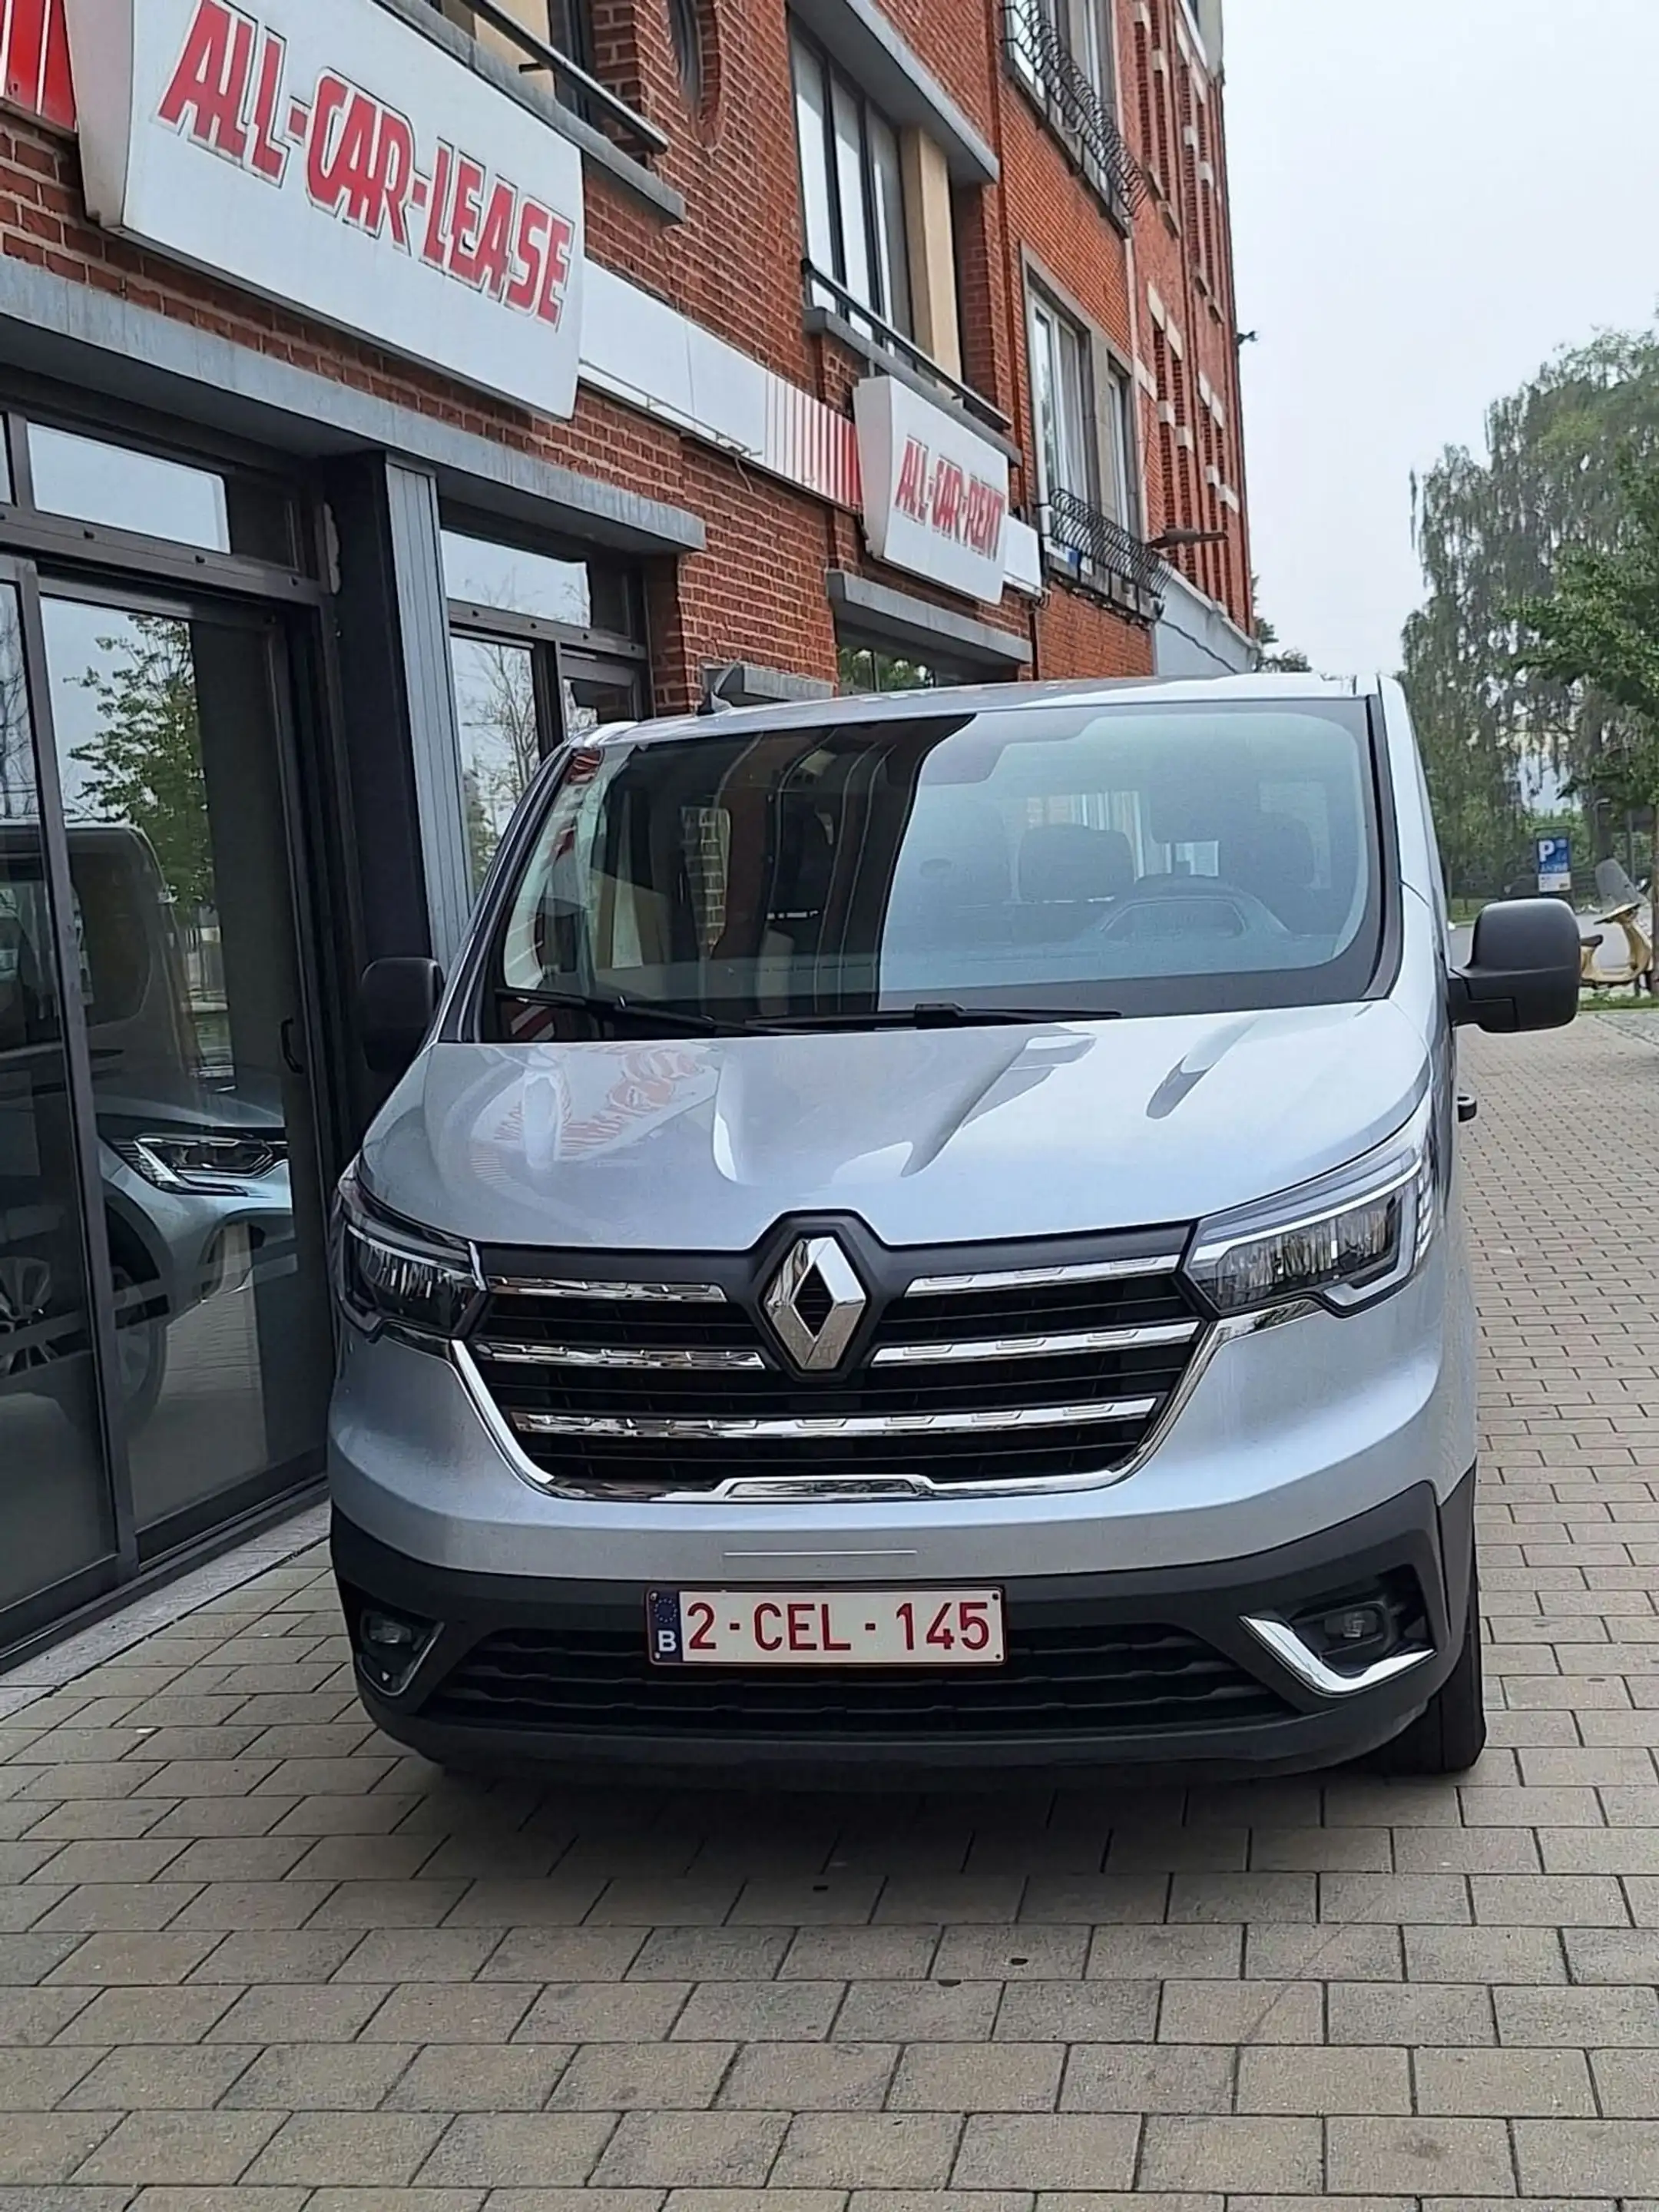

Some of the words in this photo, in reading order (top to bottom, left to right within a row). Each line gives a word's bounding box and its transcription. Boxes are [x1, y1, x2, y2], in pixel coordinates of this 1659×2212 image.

[156, 0, 575, 332] ALL-CAR-LEASE
[894, 435, 1005, 562] ALL-CAR-RENT
[1538, 839, 1555, 862] P
[657, 1629, 677, 1653] B
